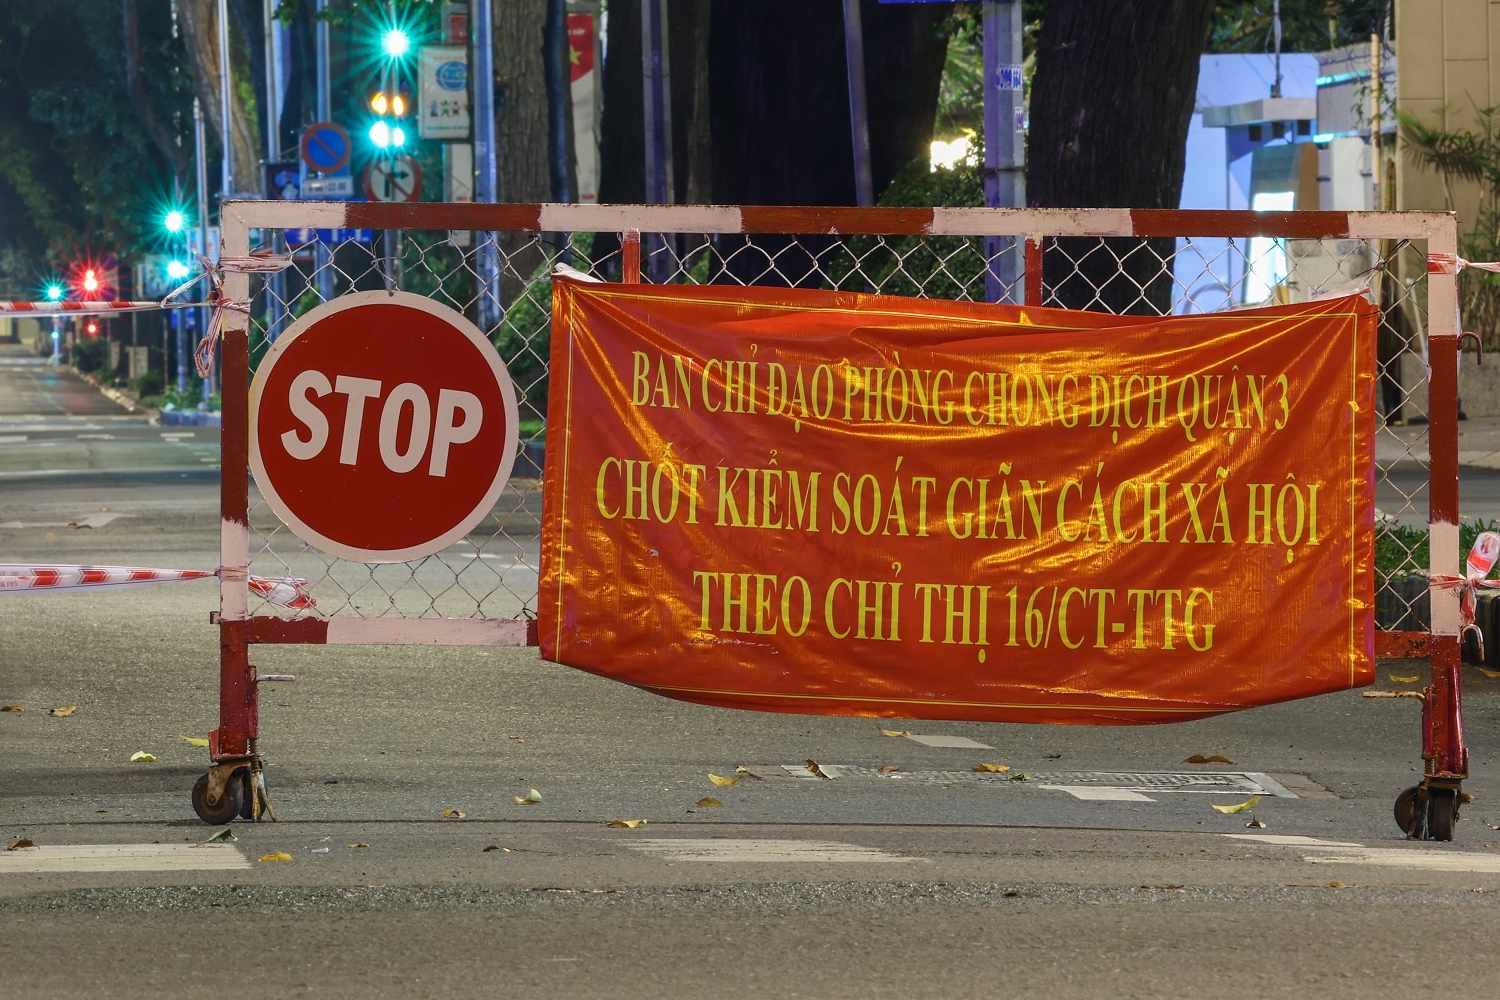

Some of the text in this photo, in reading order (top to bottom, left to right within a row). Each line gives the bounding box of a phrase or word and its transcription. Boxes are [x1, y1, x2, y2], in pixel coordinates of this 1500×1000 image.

[280, 369, 484, 478] STOP
[631, 344, 1289, 445] BAN CHỈ ĐẠO PHÒNG CHỐNG DỊCH QUẬN 3
[596, 441, 1320, 564] CHỐT KIỂM SOÁT GIÃN CÁCH XÃ HỘI
[693, 561, 1215, 664] THEO CHỈ THỊ 16/CT-TTG
